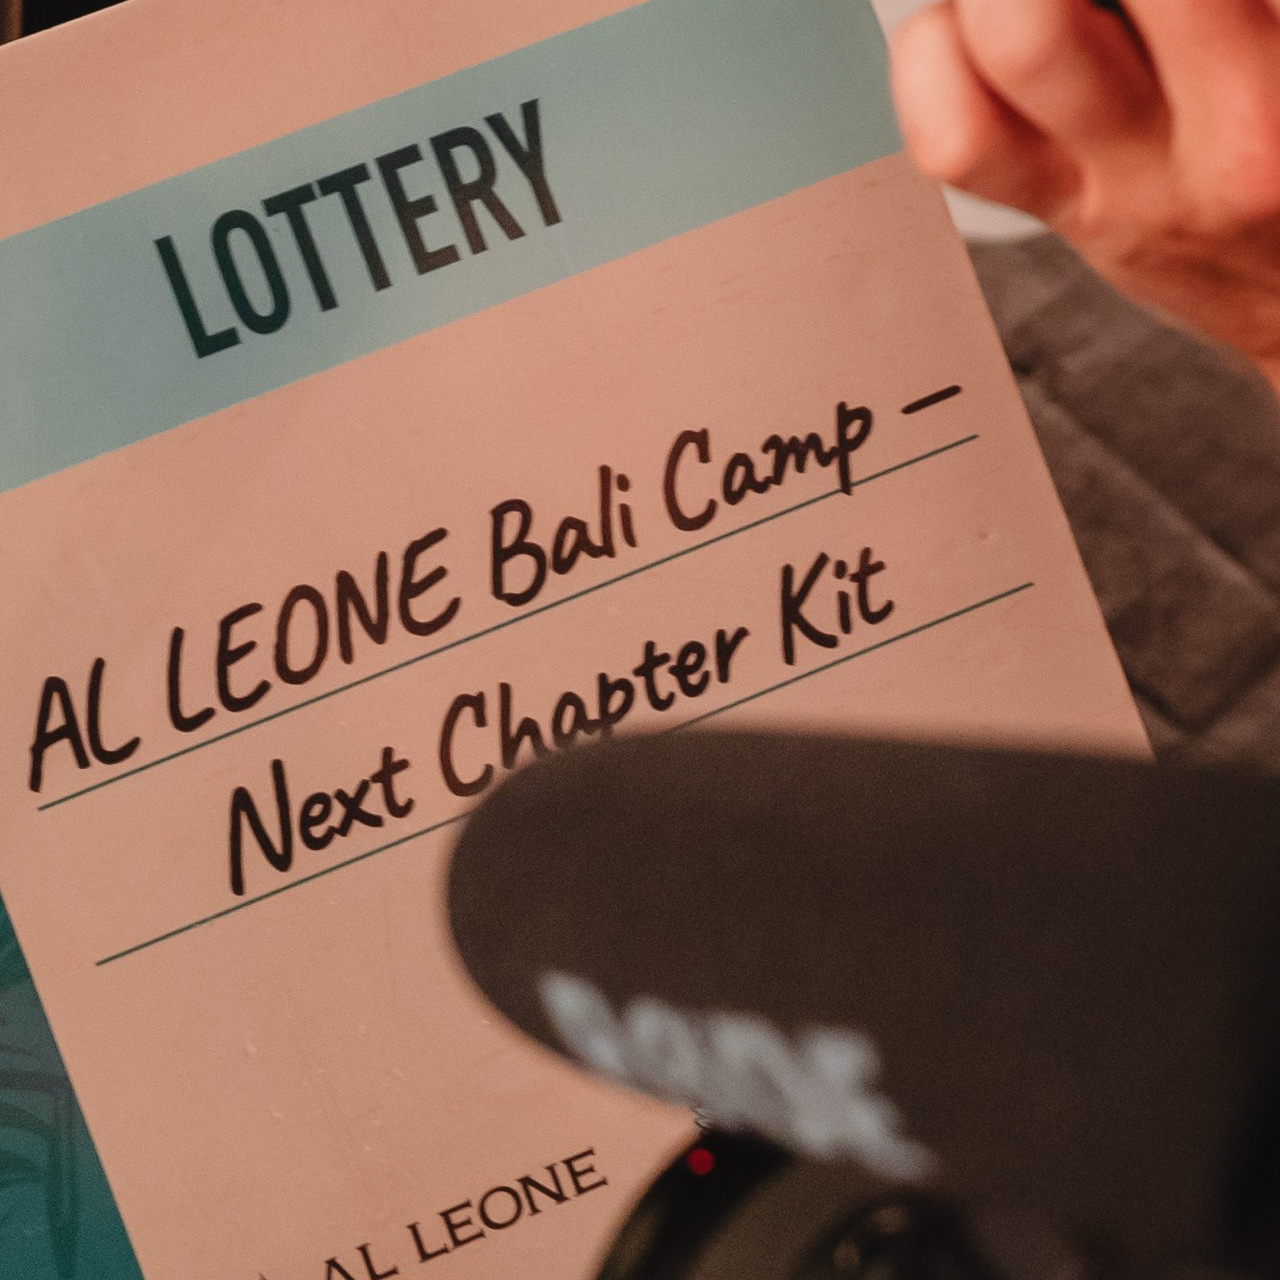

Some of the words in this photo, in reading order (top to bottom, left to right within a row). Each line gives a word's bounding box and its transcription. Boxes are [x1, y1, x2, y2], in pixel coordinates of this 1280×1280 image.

[153, 98, 563, 359] LOTTERY
[29, 657, 141, 793] AL
[165, 527, 461, 733] LEONE
[489, 464, 638, 606] Bali
[662, 402, 874, 531] Camp
[228, 746, 416, 896] Next
[438, 626, 749, 797] Chapter
[777, 547, 894, 666] Kit
[406, 1146, 609, 1263] LEONE
